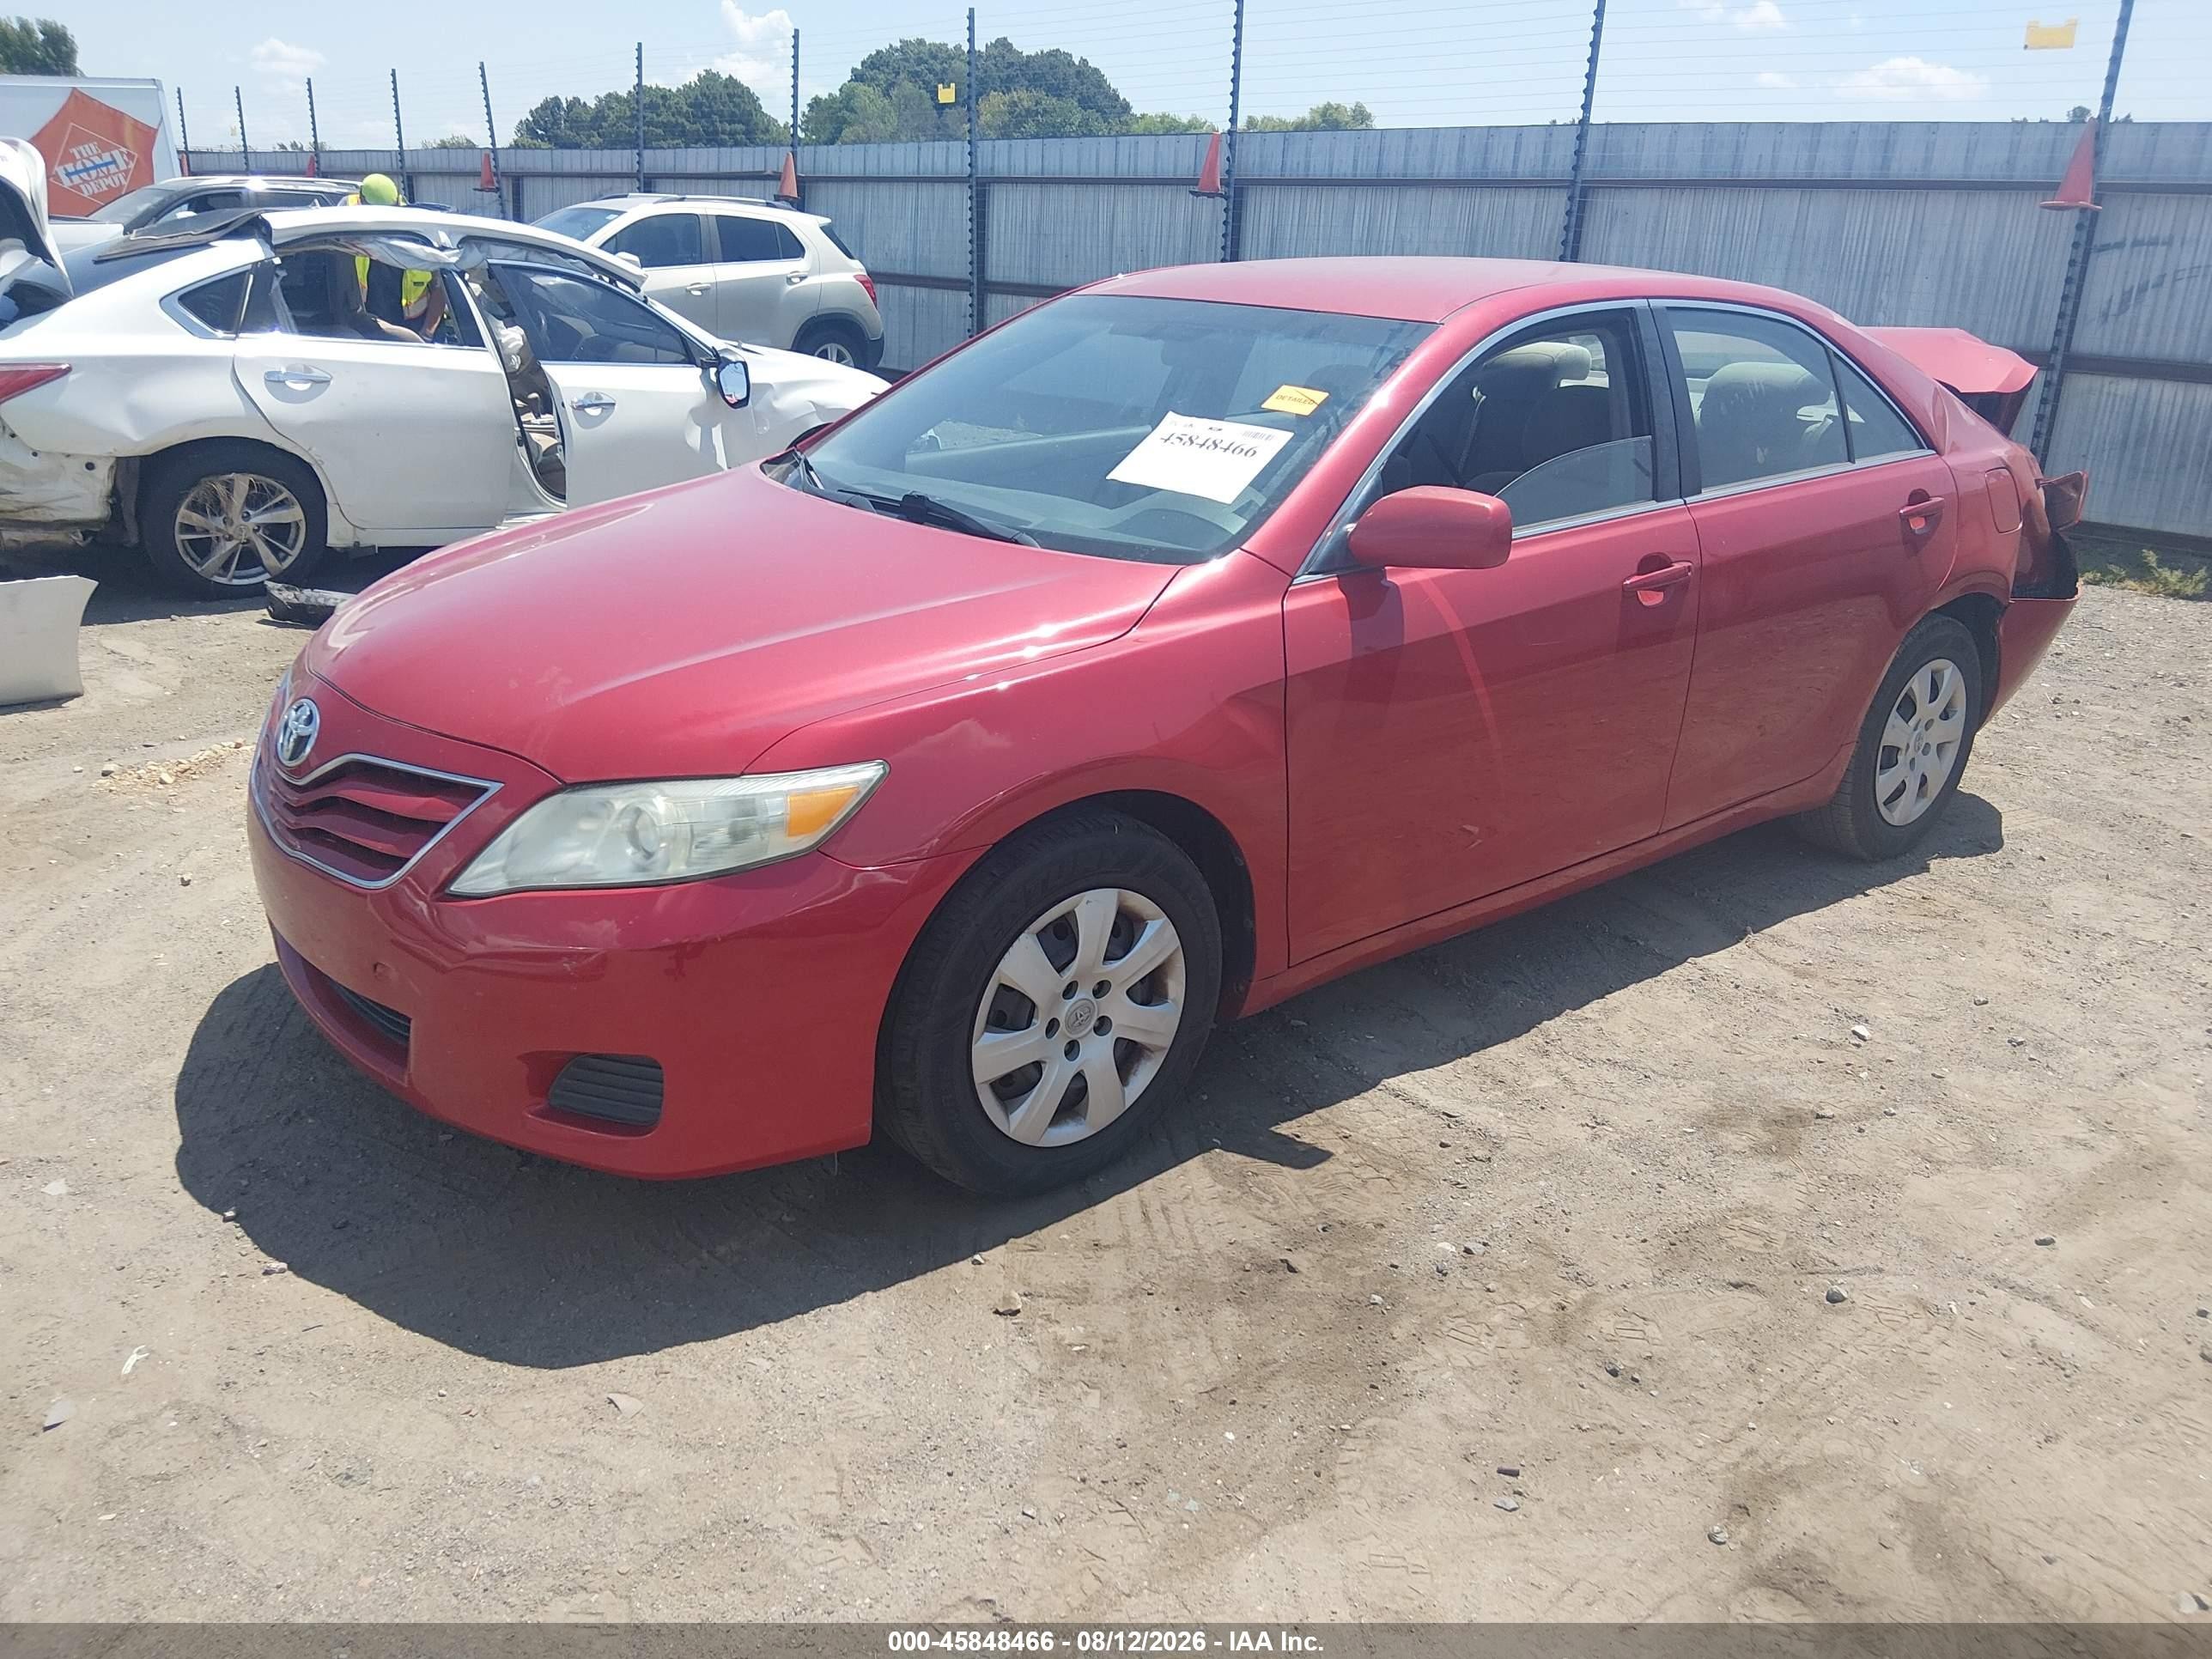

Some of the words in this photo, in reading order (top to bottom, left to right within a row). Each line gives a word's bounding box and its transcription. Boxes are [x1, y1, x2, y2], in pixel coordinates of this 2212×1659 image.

[69, 142, 102, 161] THE
[55, 149, 133, 186] HOME
[80, 172, 128, 196] DEPOT
[1160, 432, 1257, 458] 45848466
